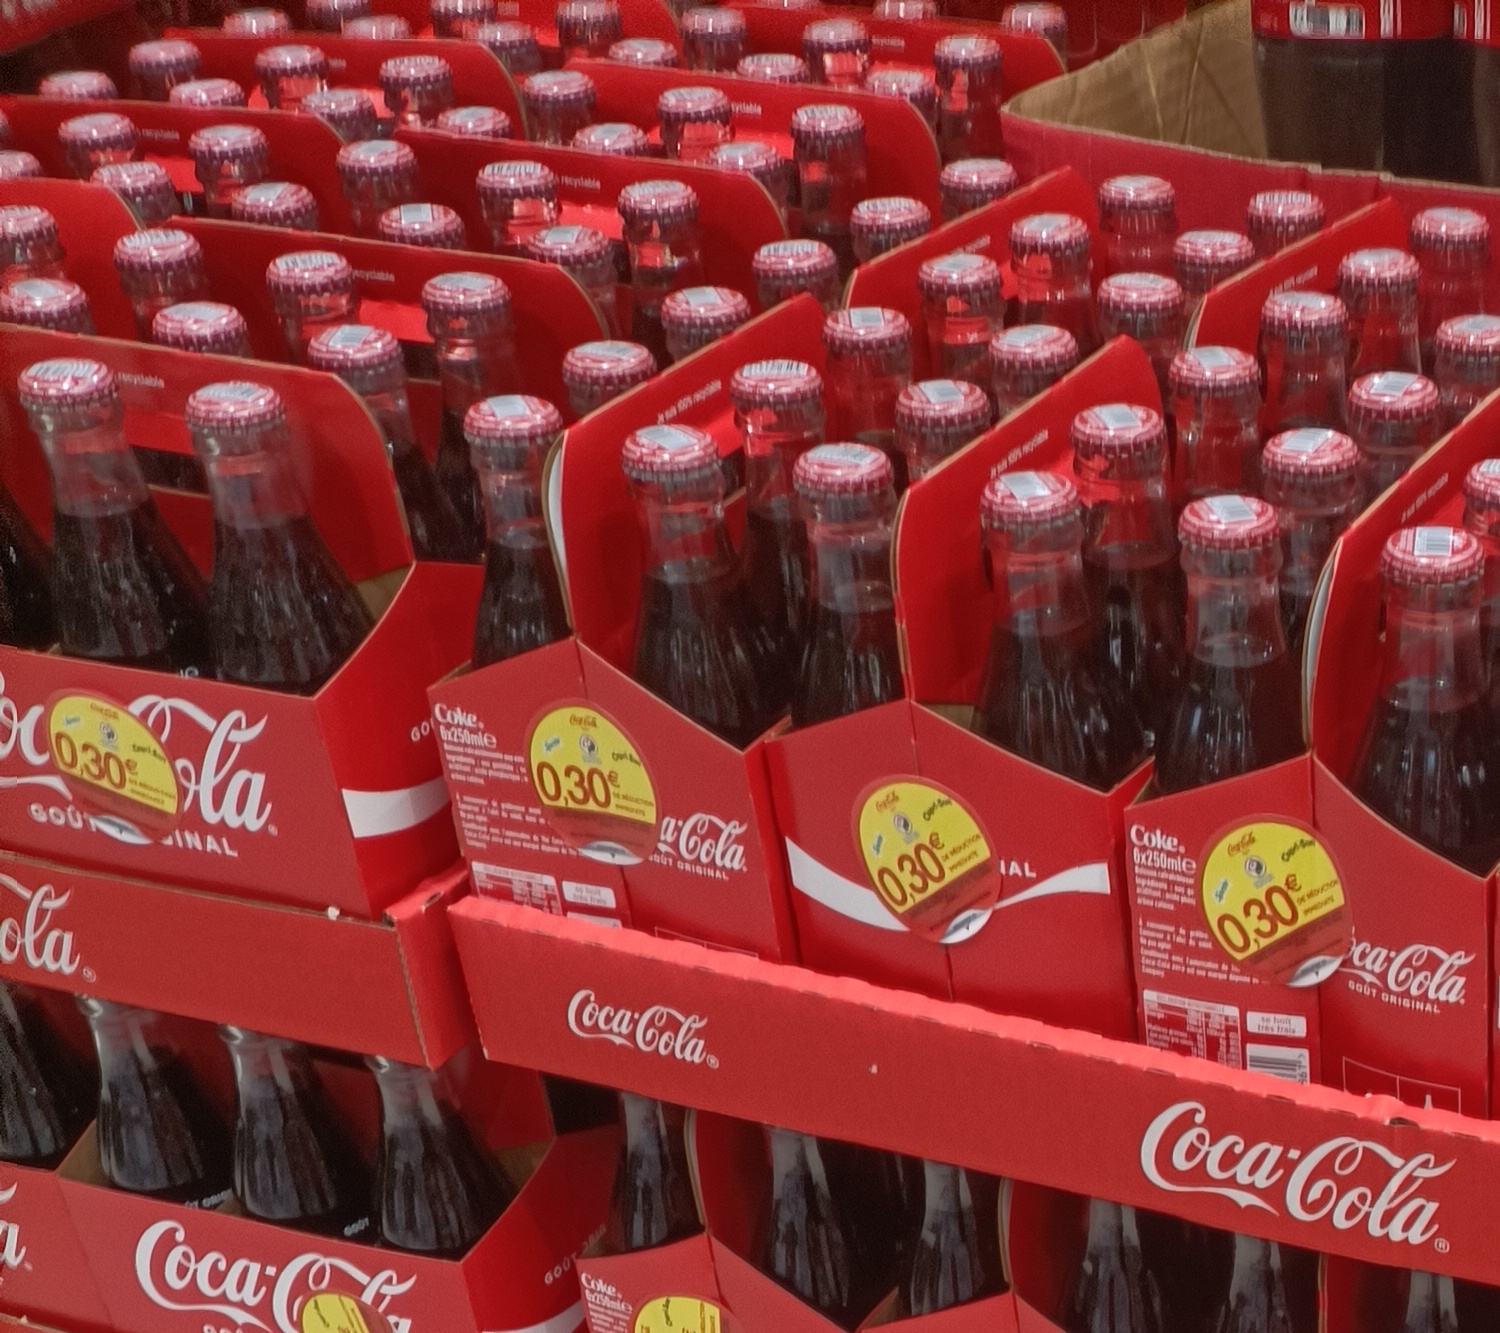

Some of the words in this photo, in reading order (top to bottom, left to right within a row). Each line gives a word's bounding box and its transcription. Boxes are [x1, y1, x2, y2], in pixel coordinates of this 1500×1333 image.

[434, 702, 480, 728] Coke
[1130, 823, 1181, 853] Coke
[676, 860, 730, 881] ORIGINAL
[1381, 991, 1441, 1016] ORIGINAL
[568, 988, 709, 1066] Coca-Cola
[1140, 1101, 1457, 1247] Coca-Cola
[580, 1272, 618, 1297] Coke
